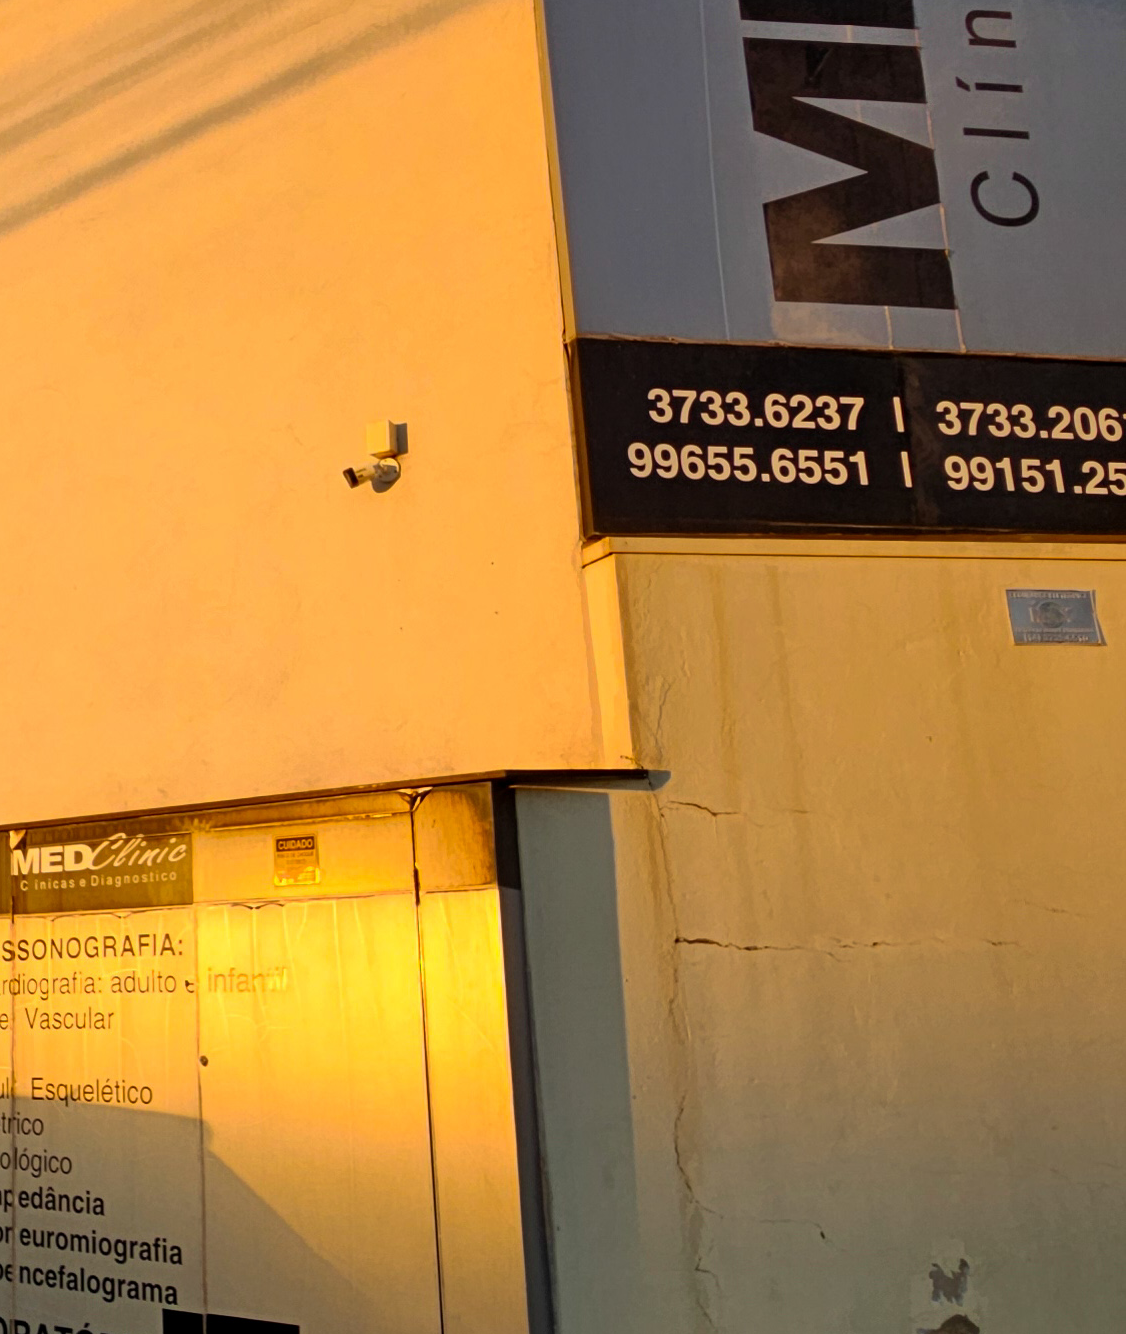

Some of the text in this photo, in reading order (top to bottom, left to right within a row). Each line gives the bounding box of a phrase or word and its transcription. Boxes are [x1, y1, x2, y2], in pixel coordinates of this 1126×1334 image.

[648, 388, 864, 431] 3733.6237
[936, 401, 1126, 442] 3733.206
[627, 442, 869, 485] 99655.6551
[278, 839, 313, 849] CUIDADO
[79, 877, 86, 887] e
[111, 970, 177, 993] adulto
[25, 1007, 114, 1030] Vascular
[31, 1077, 153, 1107] Esquelético
